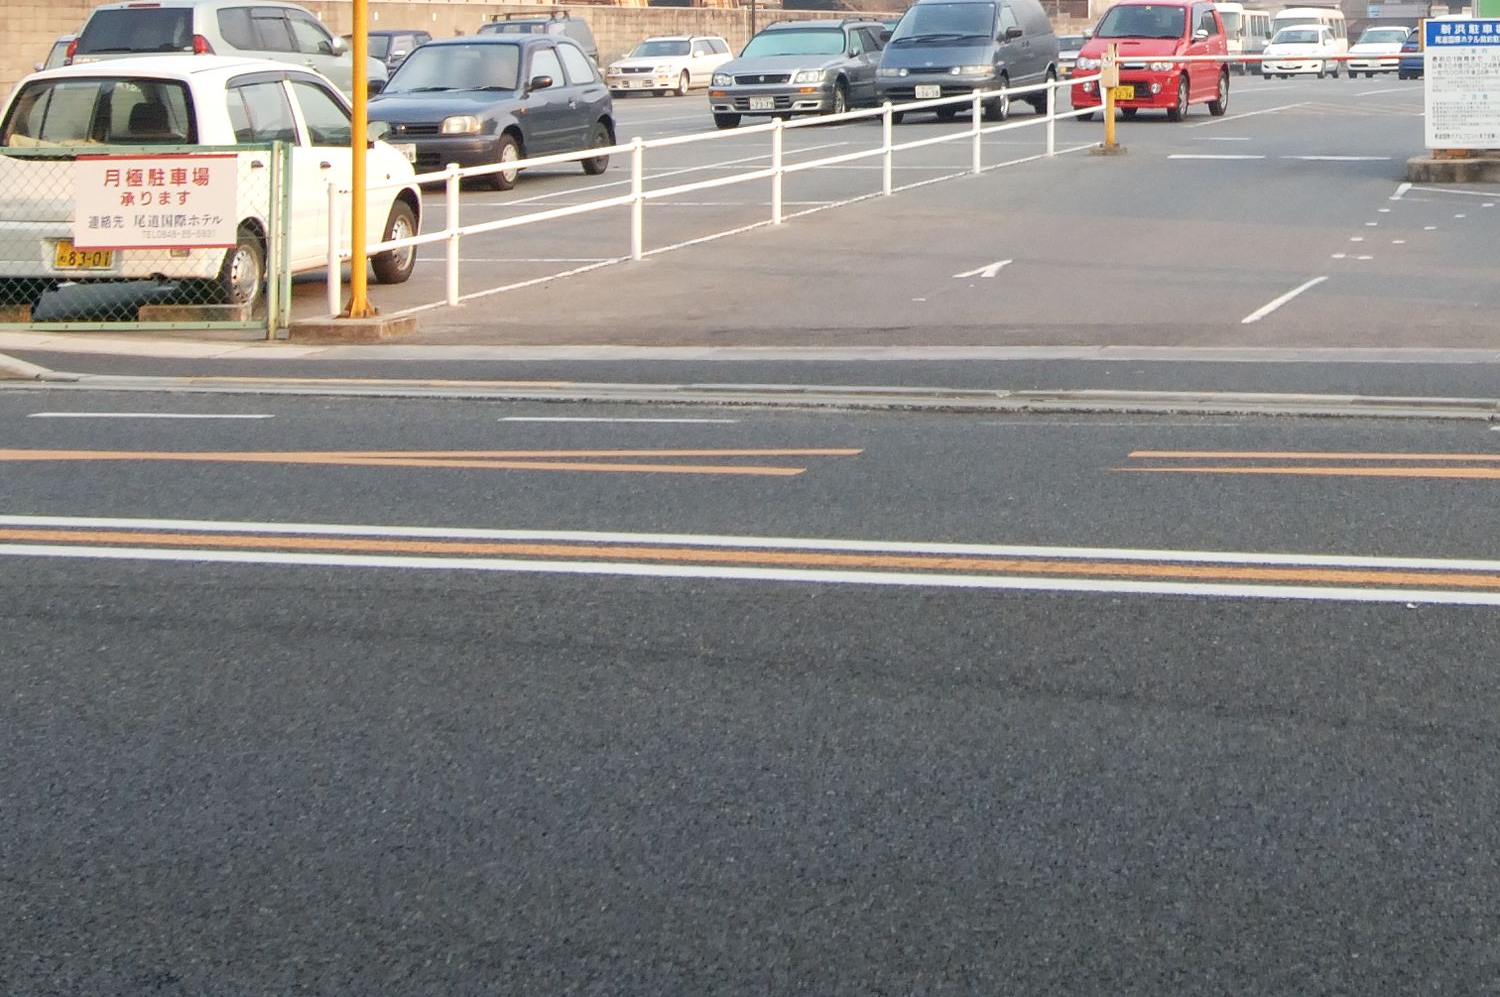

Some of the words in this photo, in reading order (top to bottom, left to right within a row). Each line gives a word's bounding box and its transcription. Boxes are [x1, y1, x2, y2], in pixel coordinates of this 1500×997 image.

[104, 167, 210, 188] 月極駐車場
[120, 191, 191, 207] 承ります
[88, 215, 125, 229] 連絡先
[133, 214, 224, 228] 尾道国際ホテル
